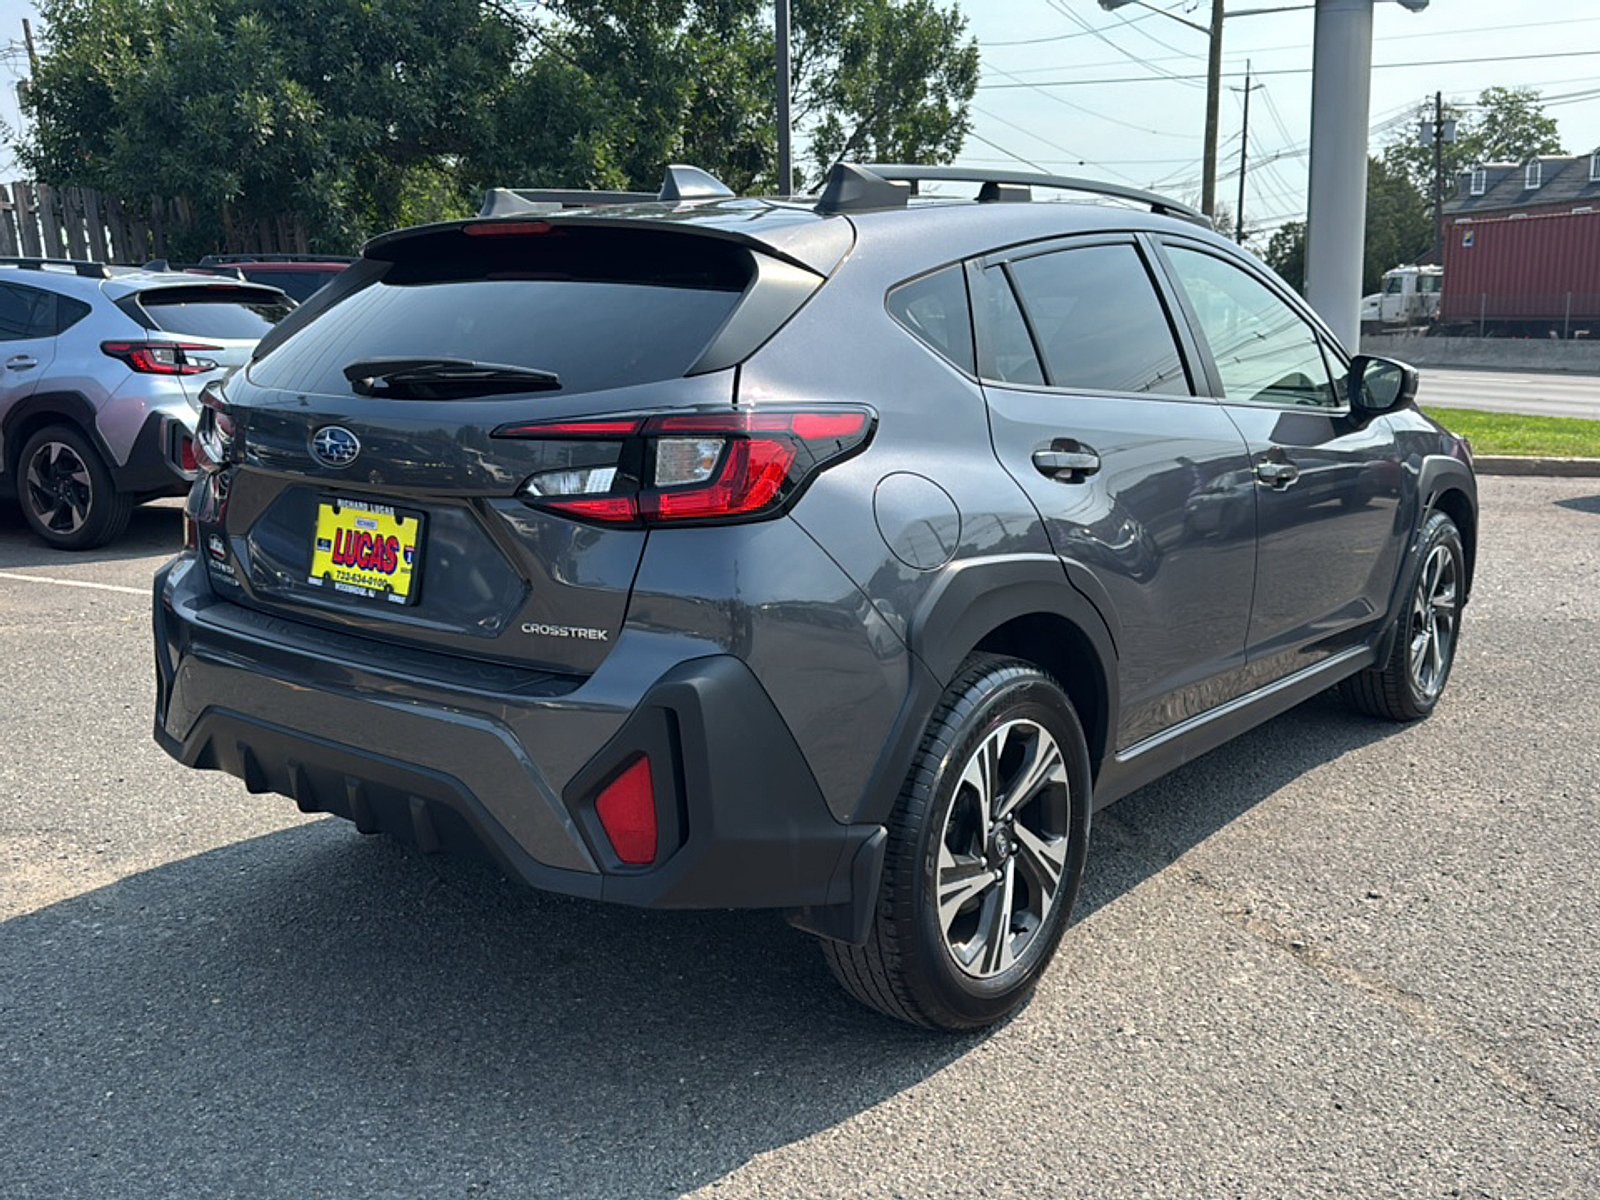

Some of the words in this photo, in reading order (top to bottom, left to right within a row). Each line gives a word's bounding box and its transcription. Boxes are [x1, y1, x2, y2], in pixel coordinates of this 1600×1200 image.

[337, 498, 368, 511] RICHARD
[370, 504, 395, 515] LUCAS
[333, 527, 400, 575] LUCAS
[521, 623, 609, 641] CROSSTREK
